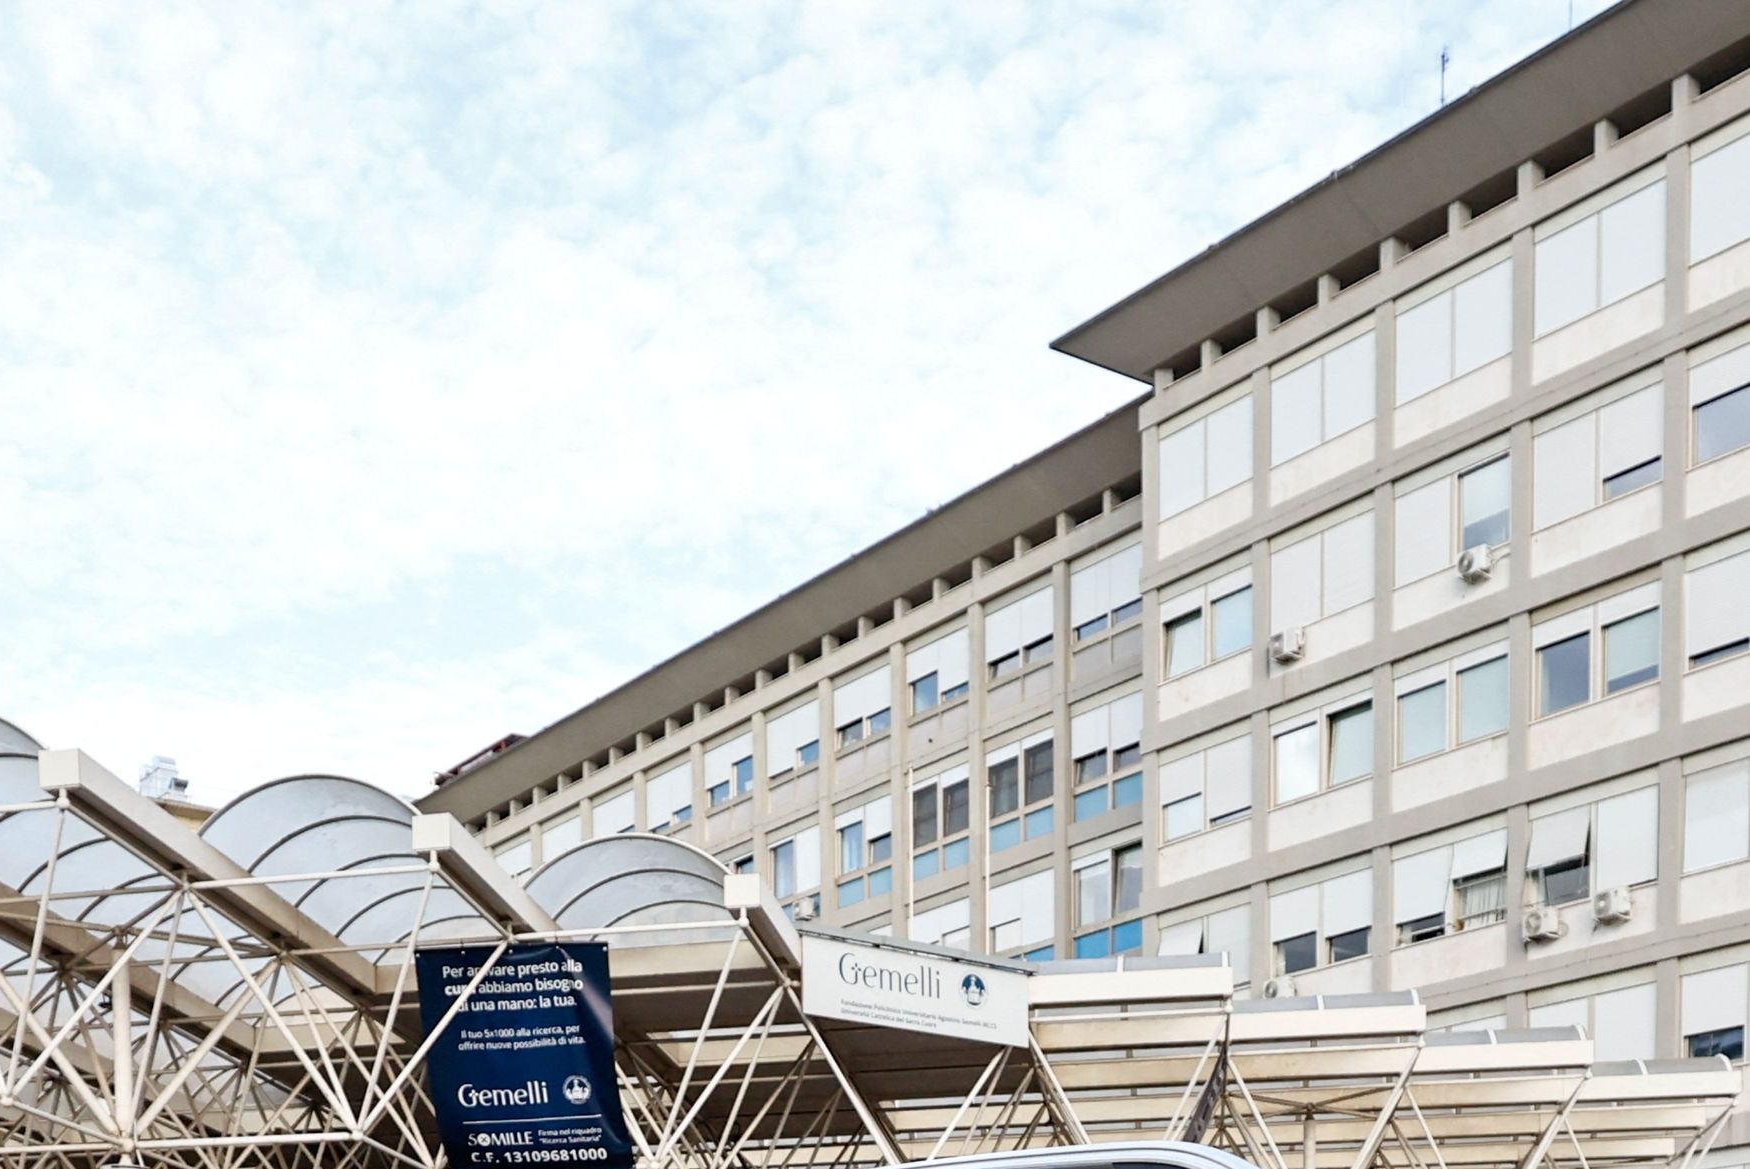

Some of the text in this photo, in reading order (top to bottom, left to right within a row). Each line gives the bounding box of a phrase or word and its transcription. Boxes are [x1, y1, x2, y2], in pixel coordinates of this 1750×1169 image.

[442, 966, 464, 978] Per
[517, 961, 559, 978] presto
[561, 959, 583, 973] alla
[839, 952, 940, 999] Gemelli
[478, 981, 533, 994] abbiamo
[535, 977, 583, 992] bisogno
[471, 1000, 495, 1011] una
[497, 998, 538, 1010] mano:
[539, 995, 551, 1008] la
[553, 995, 577, 1006] tua.
[468, 1030, 483, 1039] tuo
[484, 1028, 514, 1039] 5x1000
[515, 1027, 531, 1037] alla
[565, 1025, 580, 1034] per
[458, 1041, 485, 1051] offrire
[486, 1041, 512, 1050] nuove
[558, 1036, 566, 1045] di
[457, 1080, 549, 1108] Gemelli
[471, 1147, 608, 1164] C.F. 13109681000
